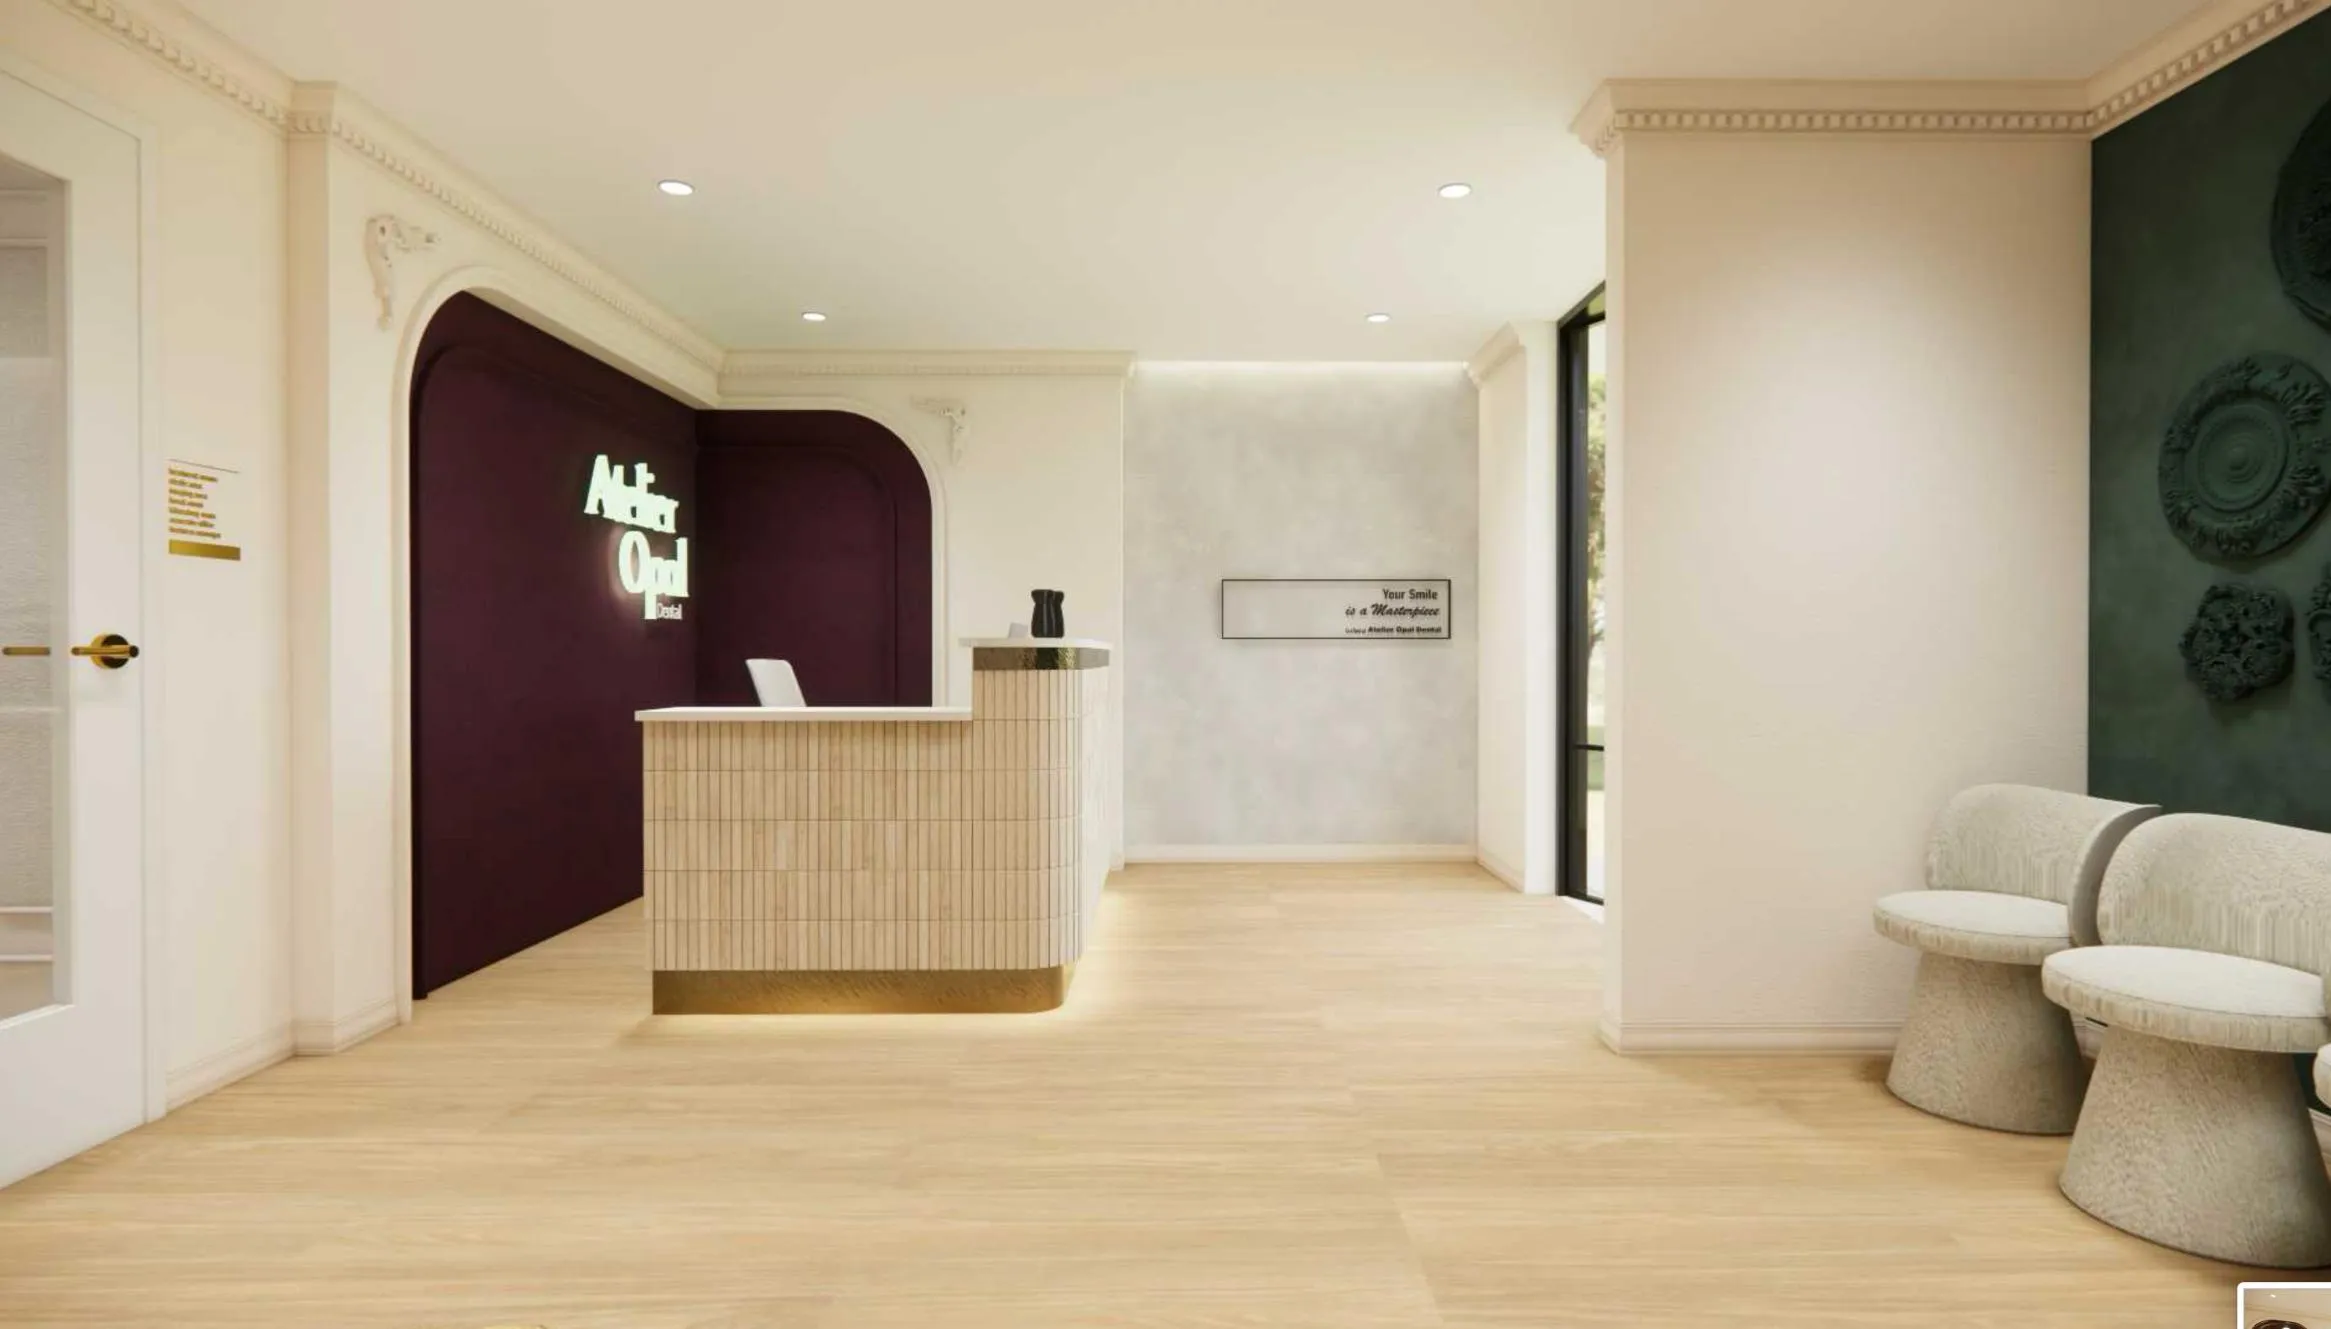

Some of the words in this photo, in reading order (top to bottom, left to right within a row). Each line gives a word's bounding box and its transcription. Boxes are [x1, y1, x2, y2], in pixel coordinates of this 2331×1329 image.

[583, 454, 680, 534] Atelier
[618, 530, 689, 620] Opal
[1382, 588, 1406, 600] Your
[1408, 588, 1438, 600] Smile
[656, 602, 683, 620] Dental
[1345, 606, 1356, 616] is
[1359, 607, 1367, 616] a
[1371, 603, 1441, 618] Masterpiece
